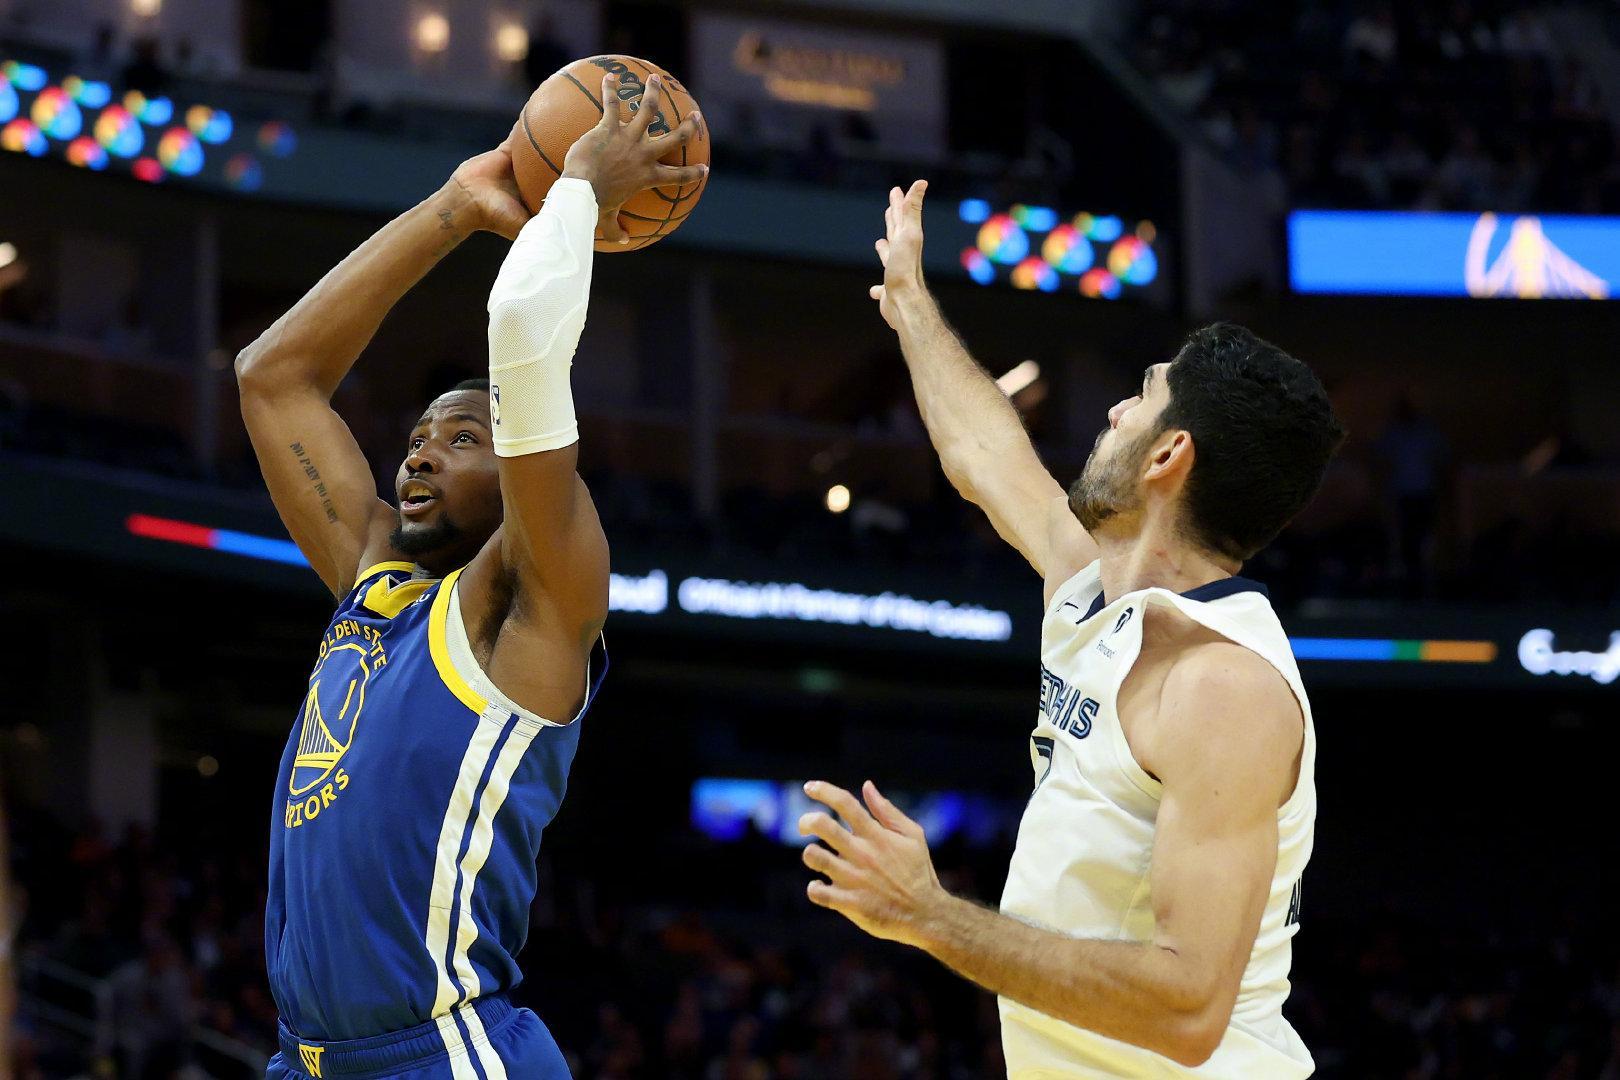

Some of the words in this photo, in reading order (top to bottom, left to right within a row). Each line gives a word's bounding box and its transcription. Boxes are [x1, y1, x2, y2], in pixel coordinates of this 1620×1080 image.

[290, 441, 305, 457] NO
[300, 457, 320, 481] PAIN
[314, 481, 328, 498] NO
[312, 619, 361, 672] OLDEN
[363, 625, 387, 671] STTE
